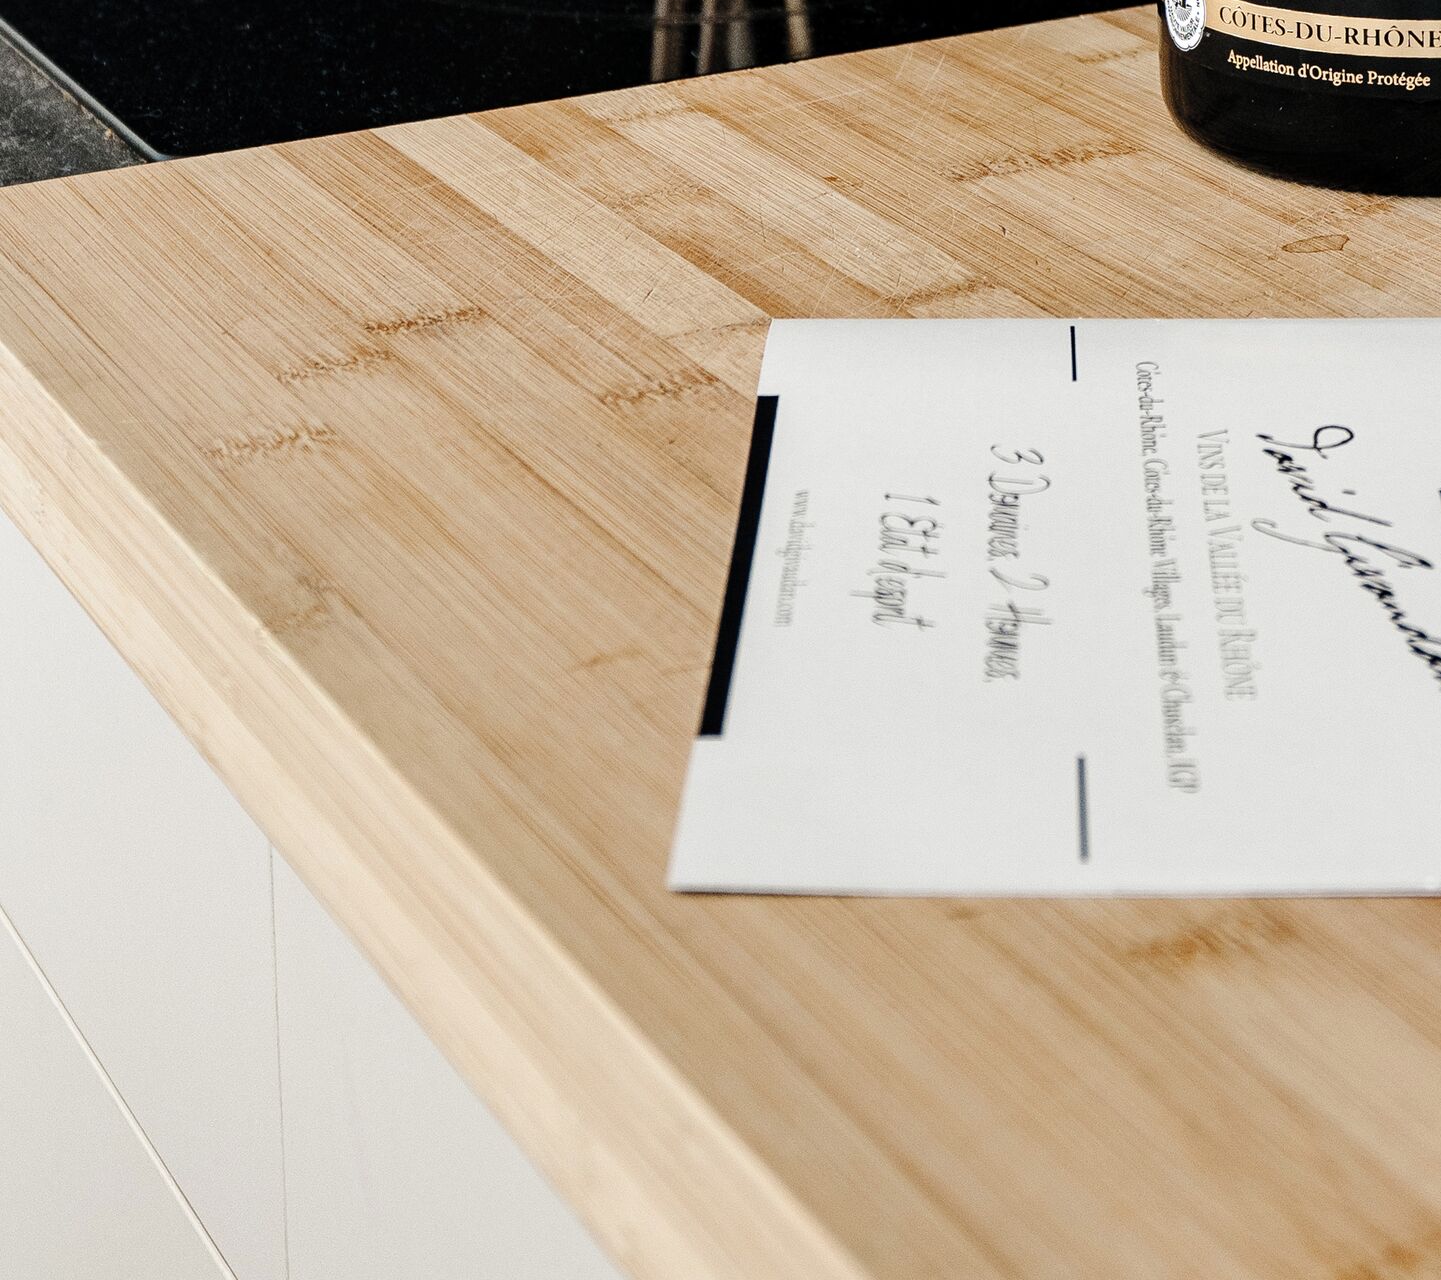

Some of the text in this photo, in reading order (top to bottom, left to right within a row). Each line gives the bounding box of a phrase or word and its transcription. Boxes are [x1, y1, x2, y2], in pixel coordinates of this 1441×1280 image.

[1227, 48, 1431, 90] Appellation d'Origine Protégée
[989, 444, 1045, 465] 3
[1255, 424, 1394, 527] David
[884, 493, 941, 506] 1
[772, 490, 816, 628] www.davidgivaudan.com
[1197, 429, 1262, 701] VINS DE LA VALLÉE DU RHÔNE
[1154, 613, 1188, 666] Laudun
